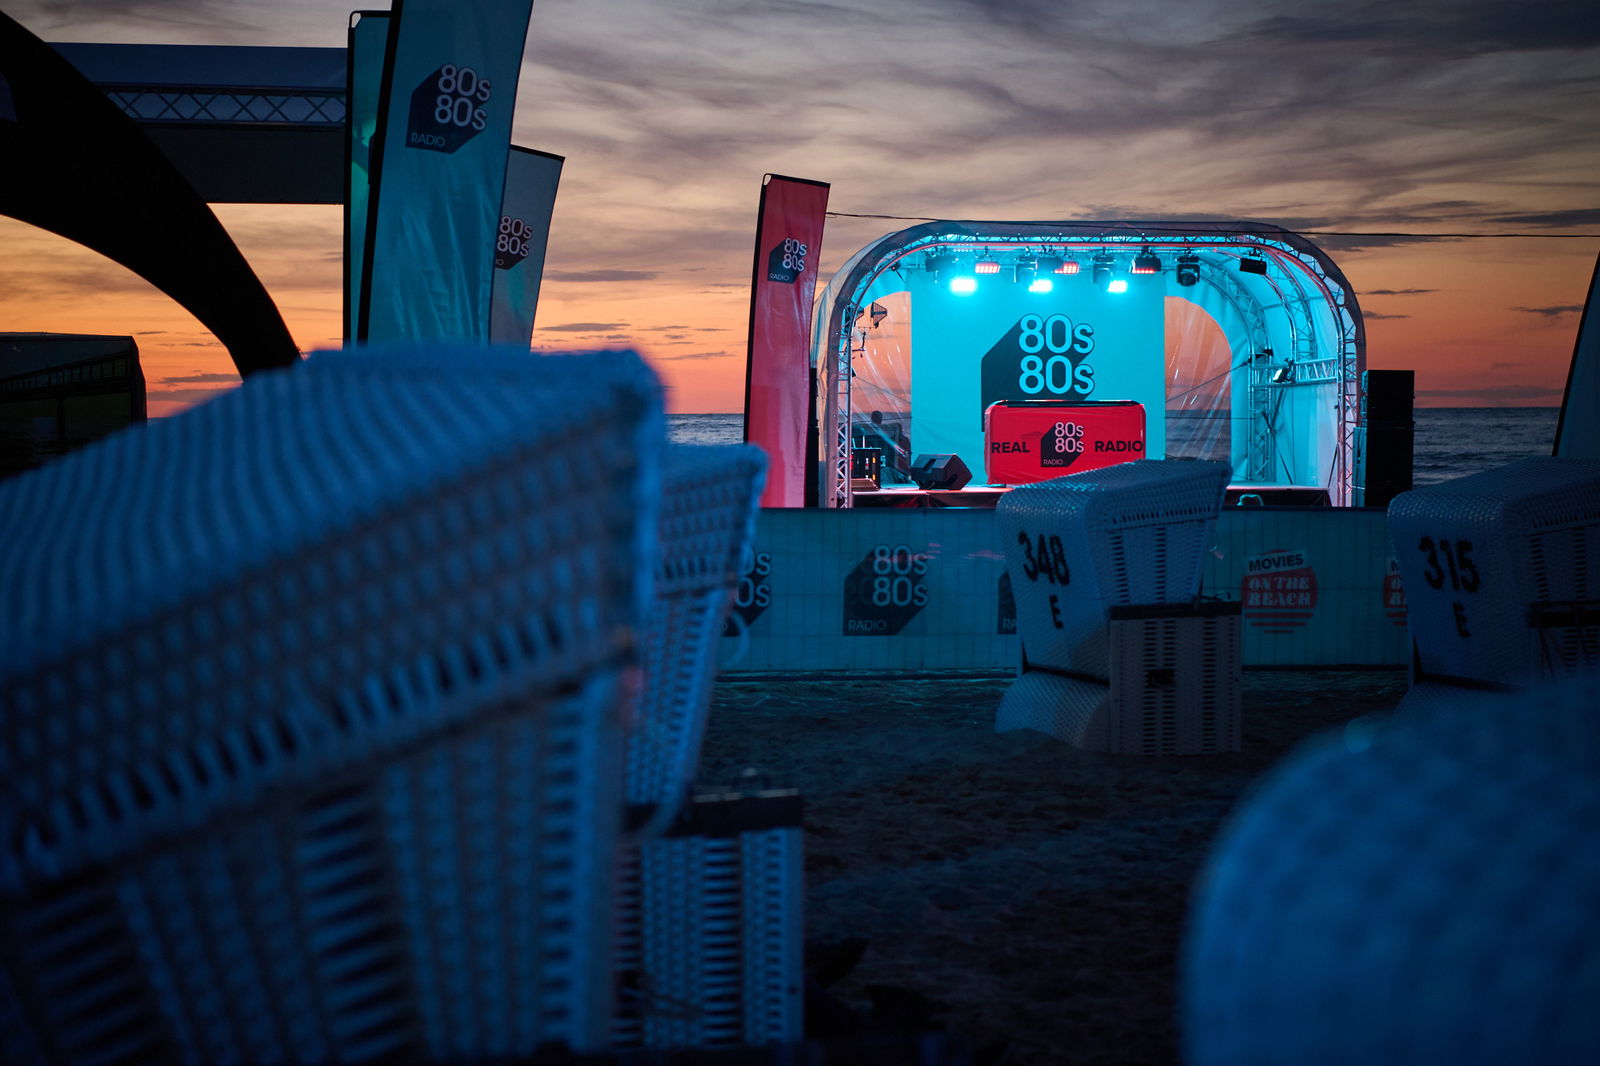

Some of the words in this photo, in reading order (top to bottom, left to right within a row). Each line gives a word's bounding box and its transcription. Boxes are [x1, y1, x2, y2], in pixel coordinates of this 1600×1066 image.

[438, 64, 491, 101] 80s
[435, 95, 487, 130] 80s
[411, 132, 445, 147] RADIO
[500, 215, 533, 240] 80s
[497, 234, 529, 257] 80s
[784, 237, 808, 257] 80s
[769, 273, 789, 281] RADIO
[782, 253, 805, 272] 80s
[1018, 314, 1095, 354] 80s
[1018, 355, 1096, 395] 80s
[1054, 421, 1085, 438] 80s
[991, 442, 1030, 453] REAL
[1095, 441, 1144, 452] RADIO
[1054, 438, 1085, 453] 80s
[740, 546, 771, 576] 0s
[872, 545, 929, 577] 80s
[1017, 530, 1070, 586] 348
[1248, 553, 1304, 572] MOVIES
[1418, 536, 1481, 593] 315
[735, 576, 771, 608] 0s
[872, 576, 929, 608] 80s
[848, 618, 888, 632] RADIO
[1048, 594, 1065, 630] E
[1453, 600, 1472, 639] E
